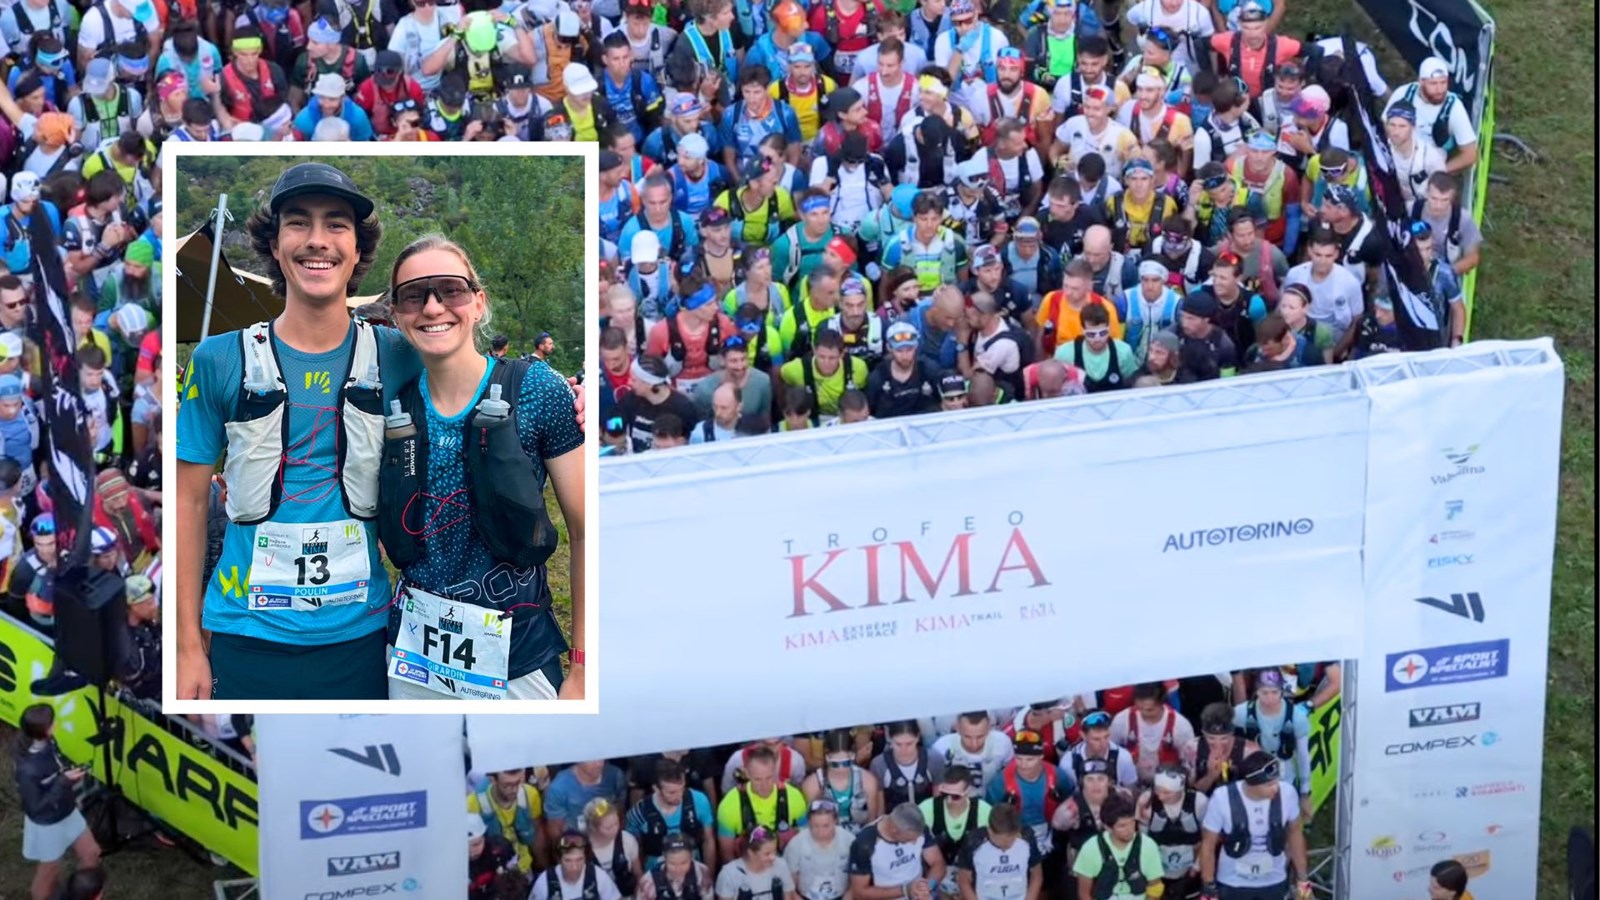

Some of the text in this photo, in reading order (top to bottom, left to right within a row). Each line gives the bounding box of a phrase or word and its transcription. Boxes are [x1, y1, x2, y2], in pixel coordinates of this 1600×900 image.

[783, 510, 1024, 554] TROFEO
[1163, 518, 1314, 553] AUTOTORINO
[303, 546, 327, 554] KIMA
[294, 554, 330, 585] 13
[782, 527, 1052, 619] KIMA
[294, 587, 329, 596] POULIN
[440, 621, 462, 634] KIMA
[915, 611, 1003, 632] KIMA TRAIL
[423, 624, 477, 670] F14
[785, 629, 840, 650] KIMA
[1429, 659, 1498, 674] SPECIALIST
[1453, 650, 1499, 664] SPORT
[427, 661, 466, 680] GIRARDIN
[1412, 703, 1478, 723] VAM
[1384, 734, 1477, 756] COMPEX
[346, 809, 416, 823] SPECIALIST
[370, 801, 417, 815] SPORT
[329, 852, 399, 872] VAM
[890, 854, 916, 870] FUGA
[990, 864, 1020, 874] FUGA
